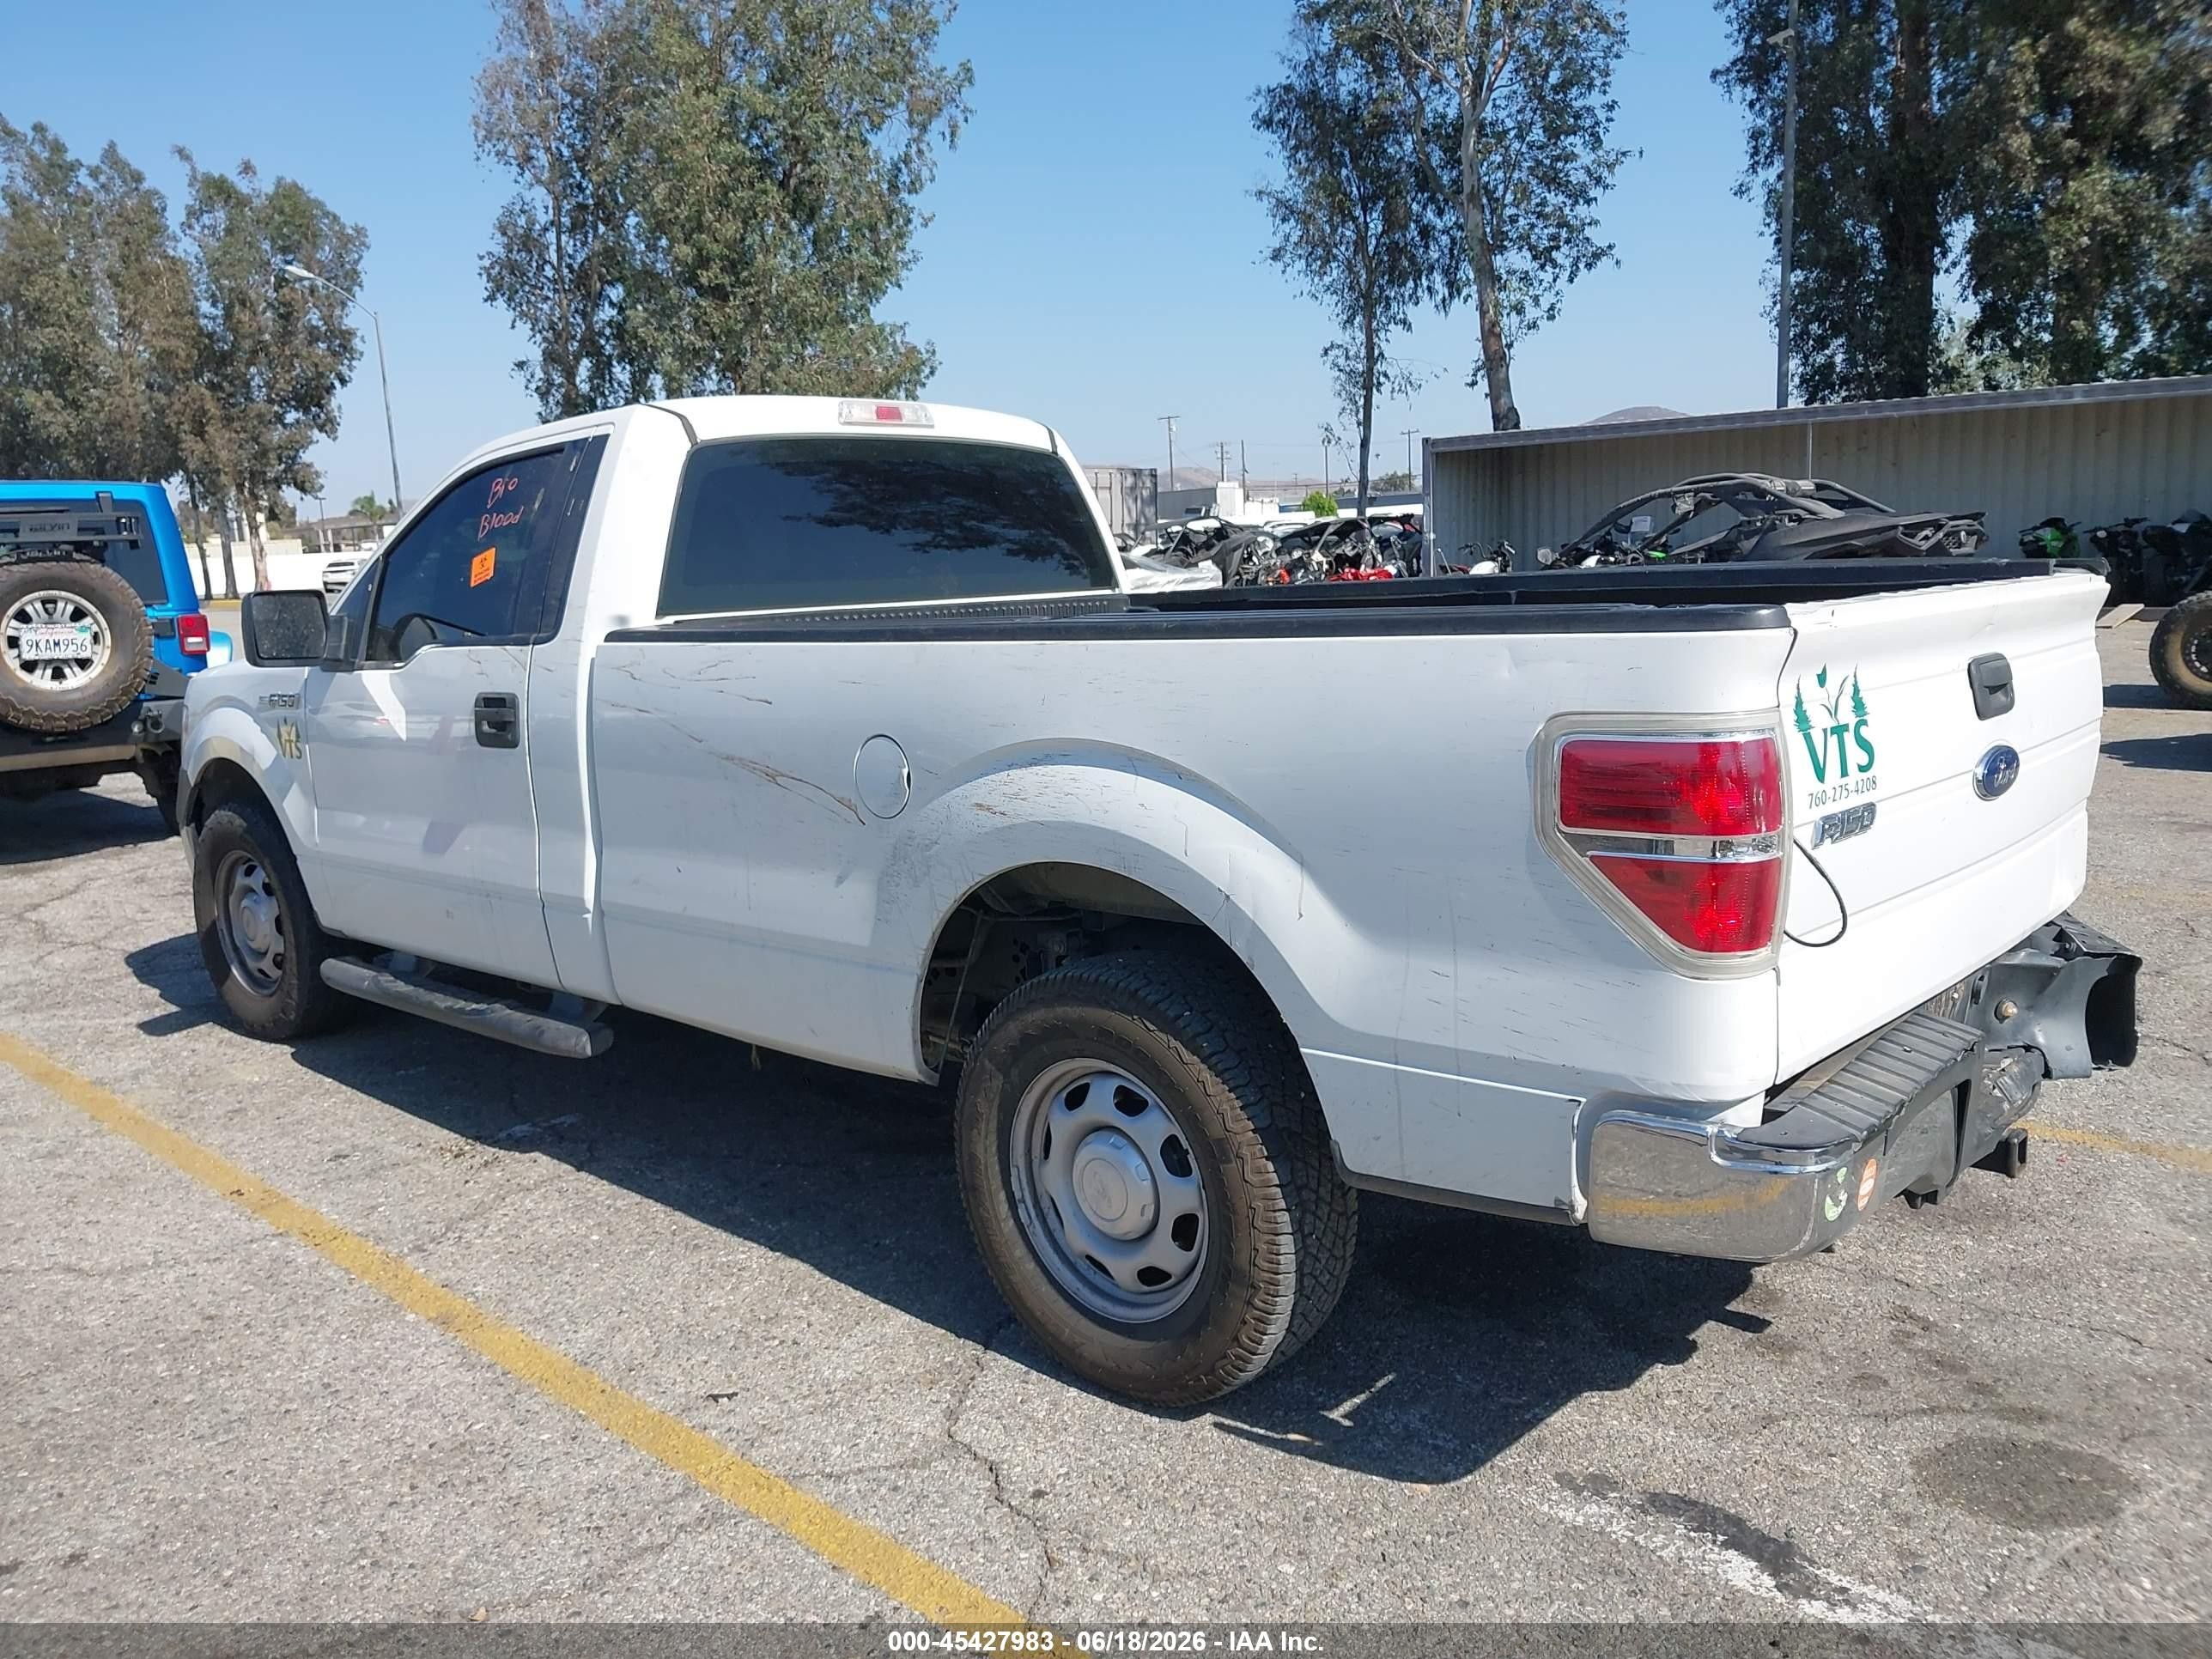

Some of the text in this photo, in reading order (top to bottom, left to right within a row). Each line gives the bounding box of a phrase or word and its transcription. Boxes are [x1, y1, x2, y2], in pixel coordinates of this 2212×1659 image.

[487, 477, 519, 509] Bio
[477, 505, 526, 542] Blood
[25, 638, 88, 653] 9KAM956
[1802, 718, 1875, 785] VTS
[1994, 756, 2018, 788] Ford
[1808, 775, 1877, 810] 760-275-4208
